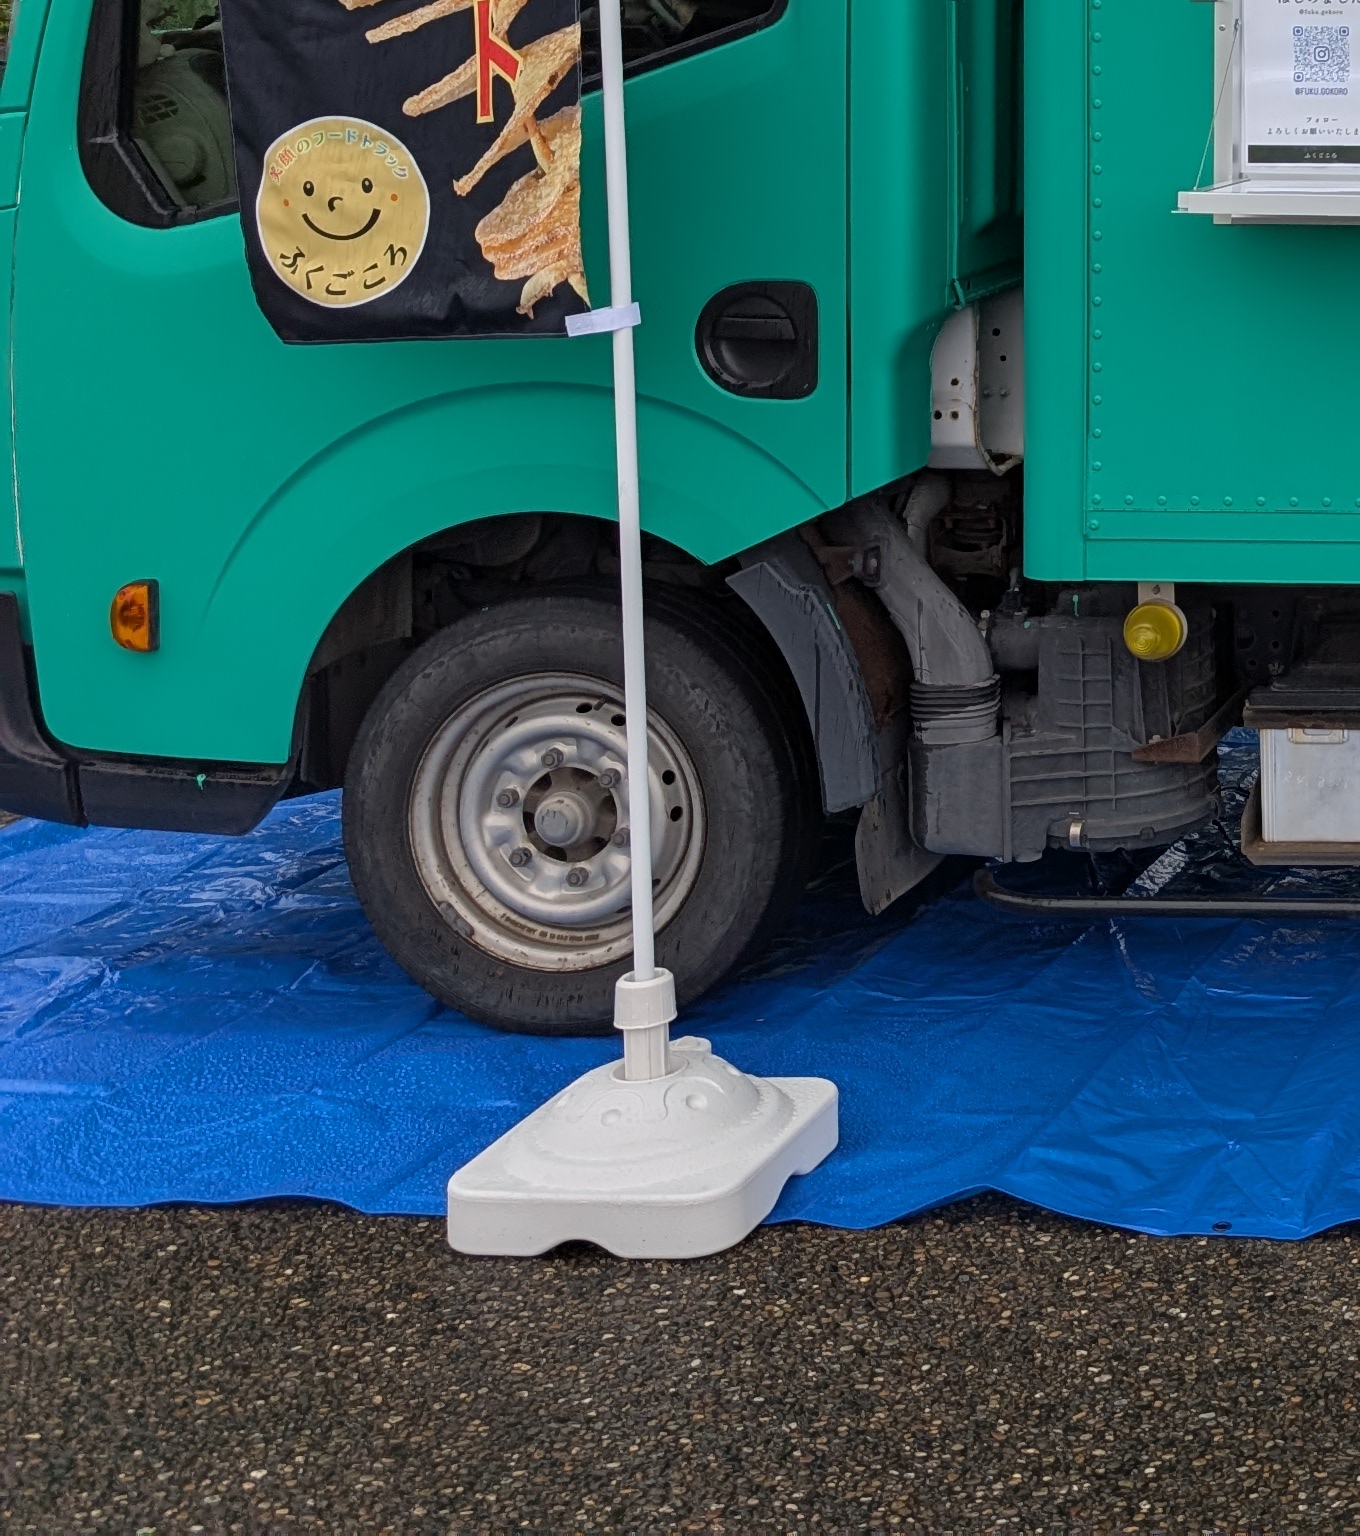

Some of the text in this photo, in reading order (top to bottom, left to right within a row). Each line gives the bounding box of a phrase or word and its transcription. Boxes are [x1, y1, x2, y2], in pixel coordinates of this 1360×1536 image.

[268, 129, 409, 186] 笑顔のフードトラック
